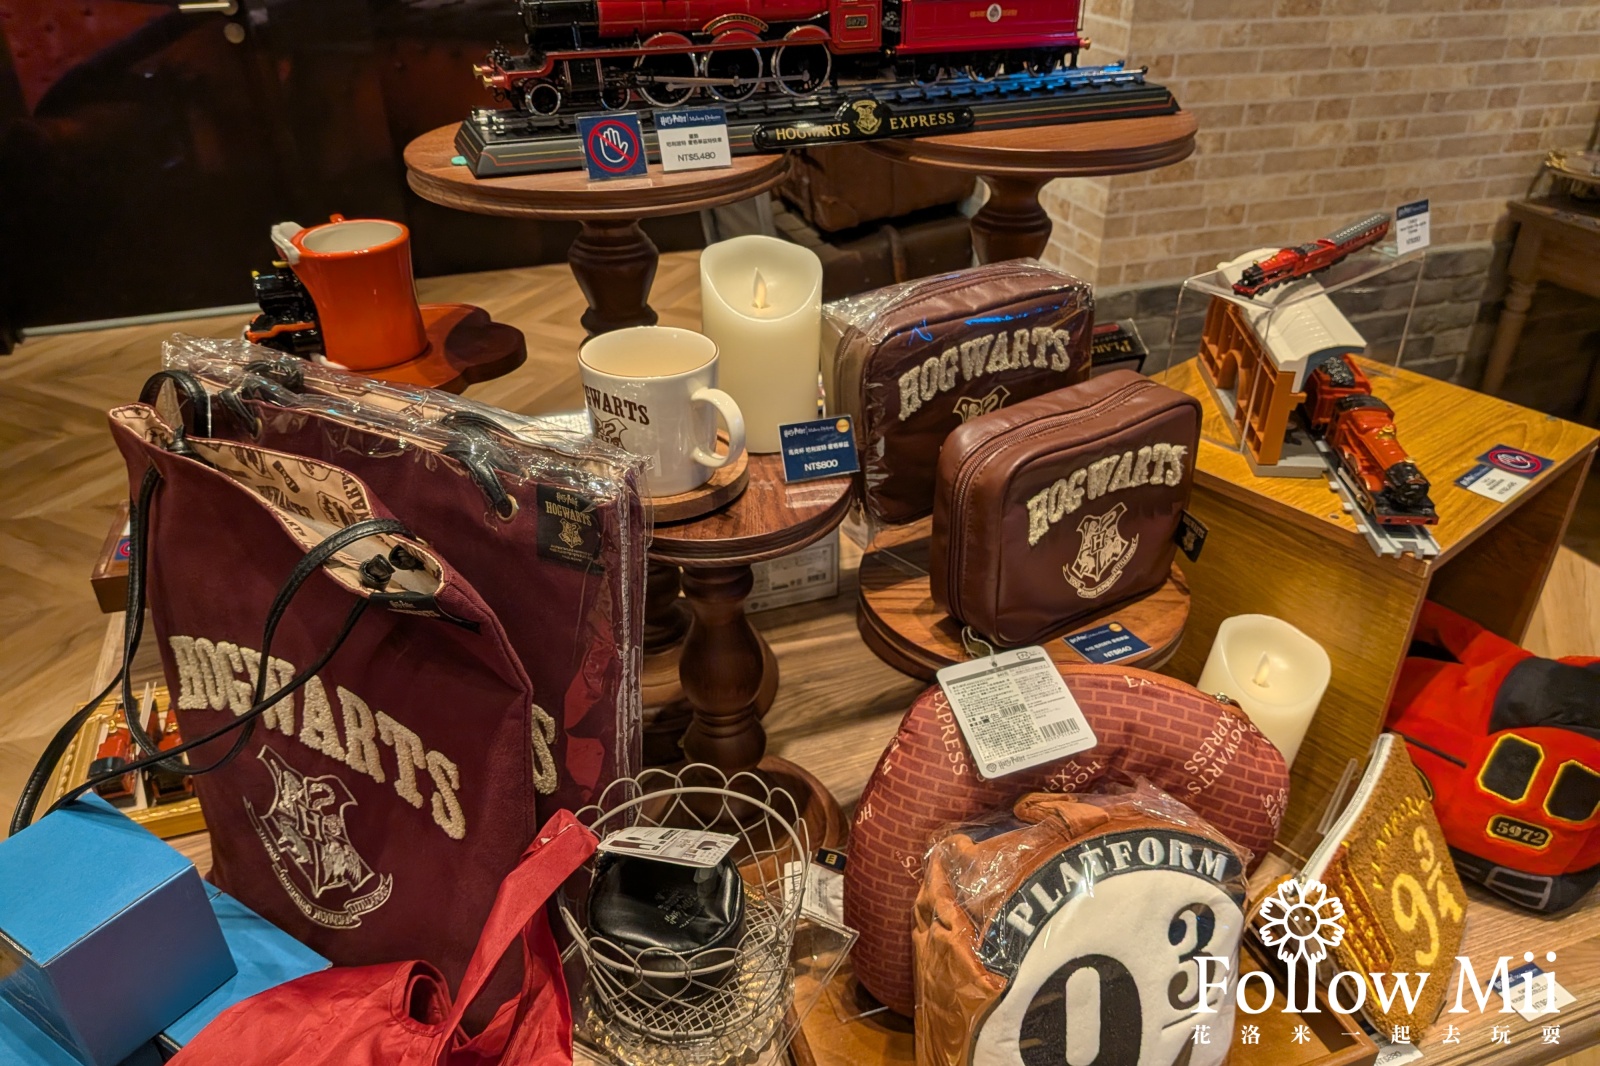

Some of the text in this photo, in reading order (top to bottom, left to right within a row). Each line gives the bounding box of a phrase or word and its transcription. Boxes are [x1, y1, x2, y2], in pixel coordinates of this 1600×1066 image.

[677, 151, 716, 162] NT$5,480
[775, 112, 955, 141] HOGWARTS EXPRESS
[582, 383, 650, 425] GWARTS
[899, 326, 1071, 421] HOGWARTS
[804, 459, 838, 471] NT$800
[1026, 443, 1188, 546] HOGWARTS
[545, 501, 592, 526] HOGWARTS
[169, 635, 466, 840] HOGWARTS
[934, 691, 969, 776] EXPRESS
[1183, 710, 1234, 775] XPRESS
[1186, 714, 1249, 796] OGWARTS
[1496, 821, 1546, 844] 5972
[1006, 836, 1229, 938] PLATFORM
